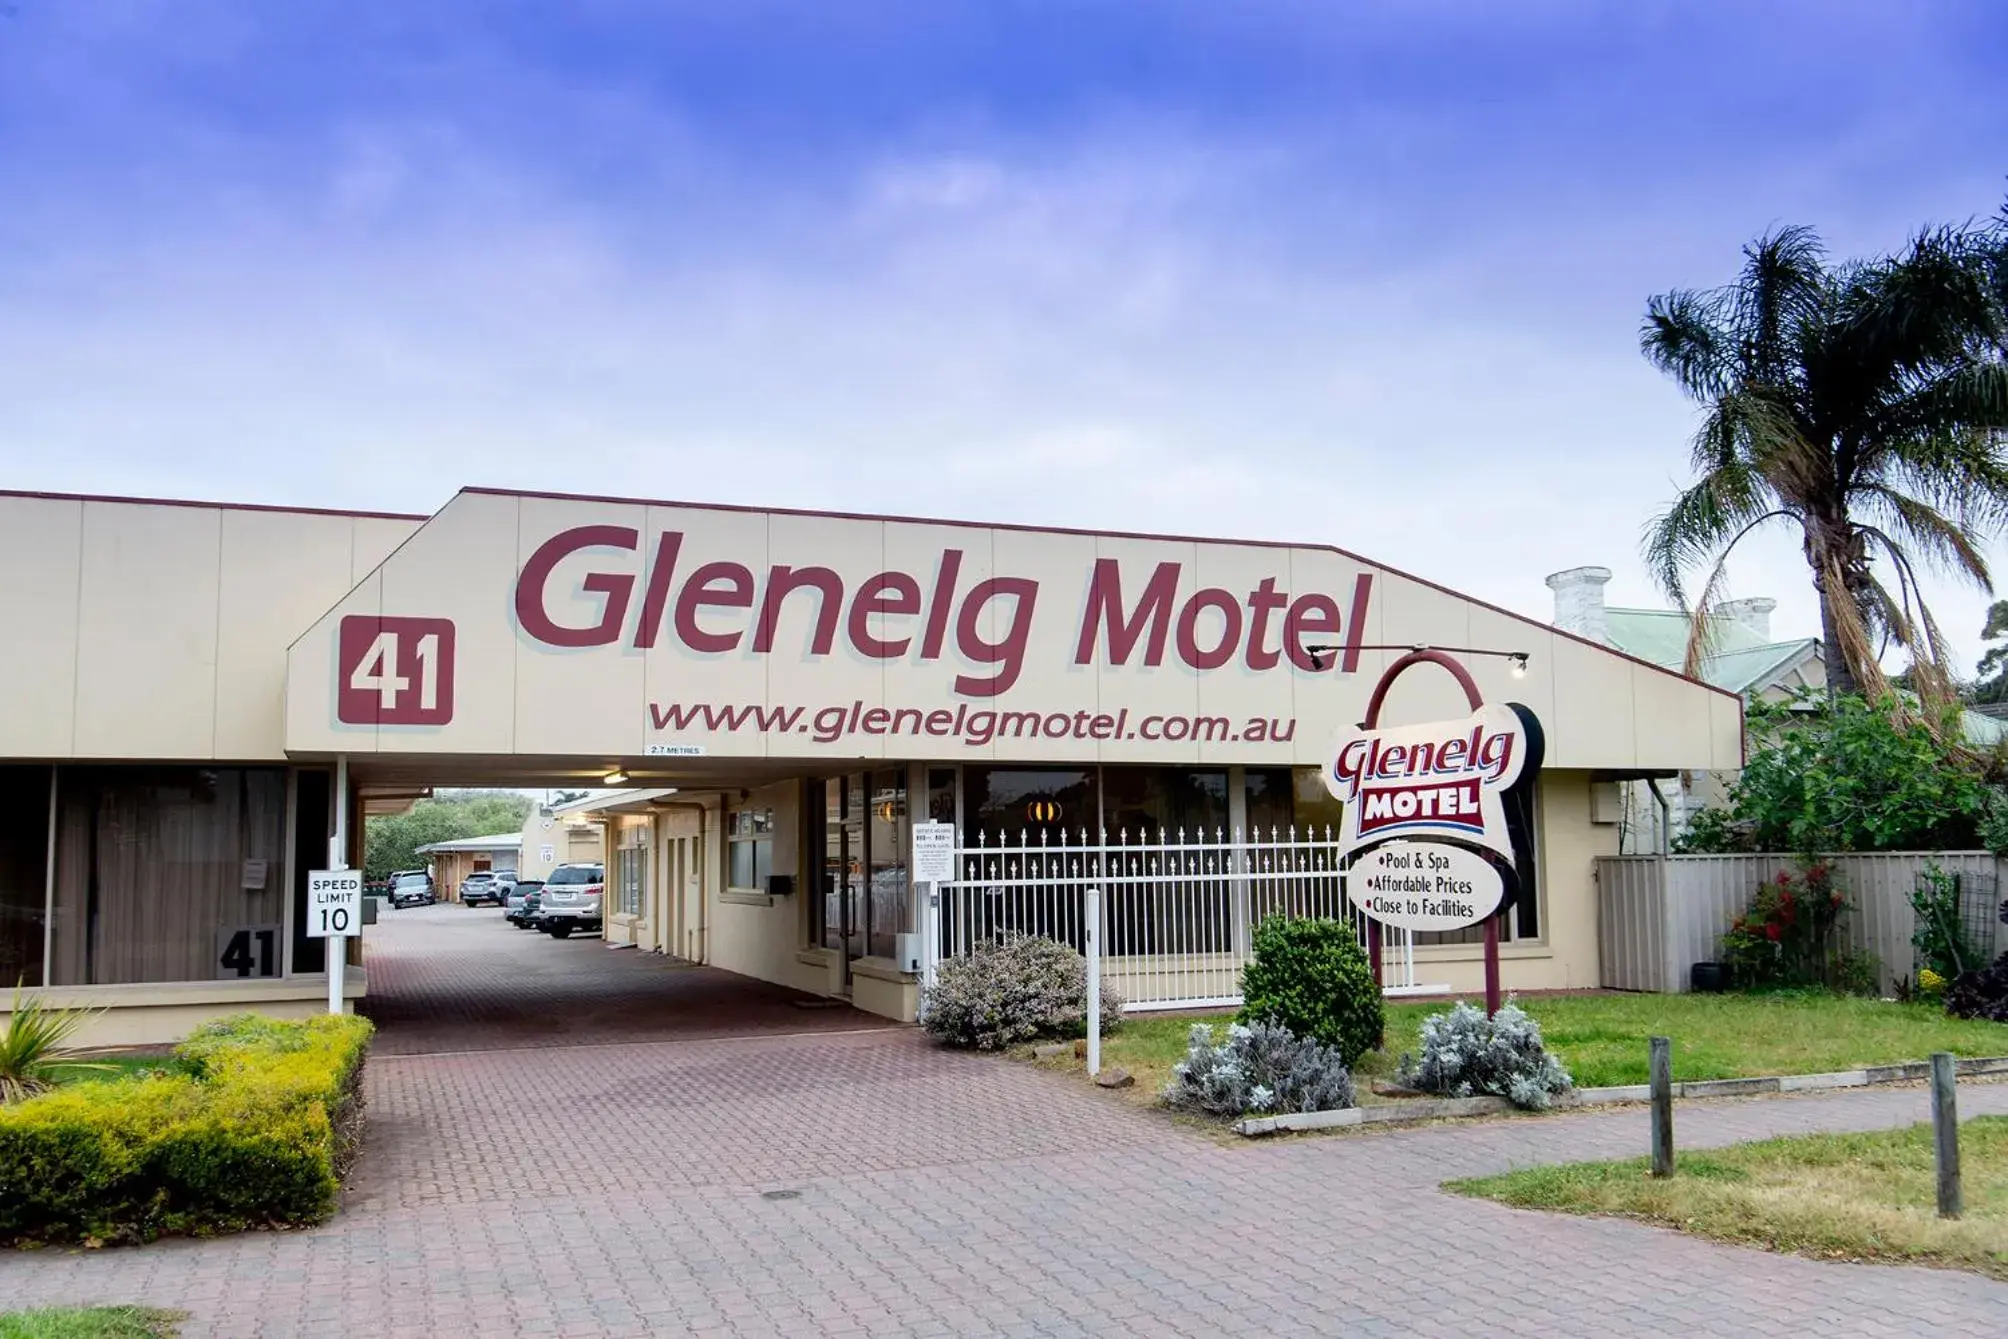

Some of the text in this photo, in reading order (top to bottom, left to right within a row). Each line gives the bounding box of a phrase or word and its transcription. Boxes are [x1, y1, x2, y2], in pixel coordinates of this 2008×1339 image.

[516, 526, 1372, 696] Glenelg Motel
[351, 632, 439, 710] 41
[649, 700, 1297, 746] www.glenelgmotel.com.au
[1335, 725, 1515, 799] Glenelg
[1364, 786, 1479, 820] MOTEL
[1386, 852, 1450, 873] Pool & Spa
[313, 880, 358, 890] SPEED
[317, 892, 353, 903] LIMIT
[1373, 875, 1472, 894] Affordable Prices
[321, 908, 349, 931] 10
[1373, 896, 1474, 917] Close to Facilities
[220, 930, 274, 977] 41
